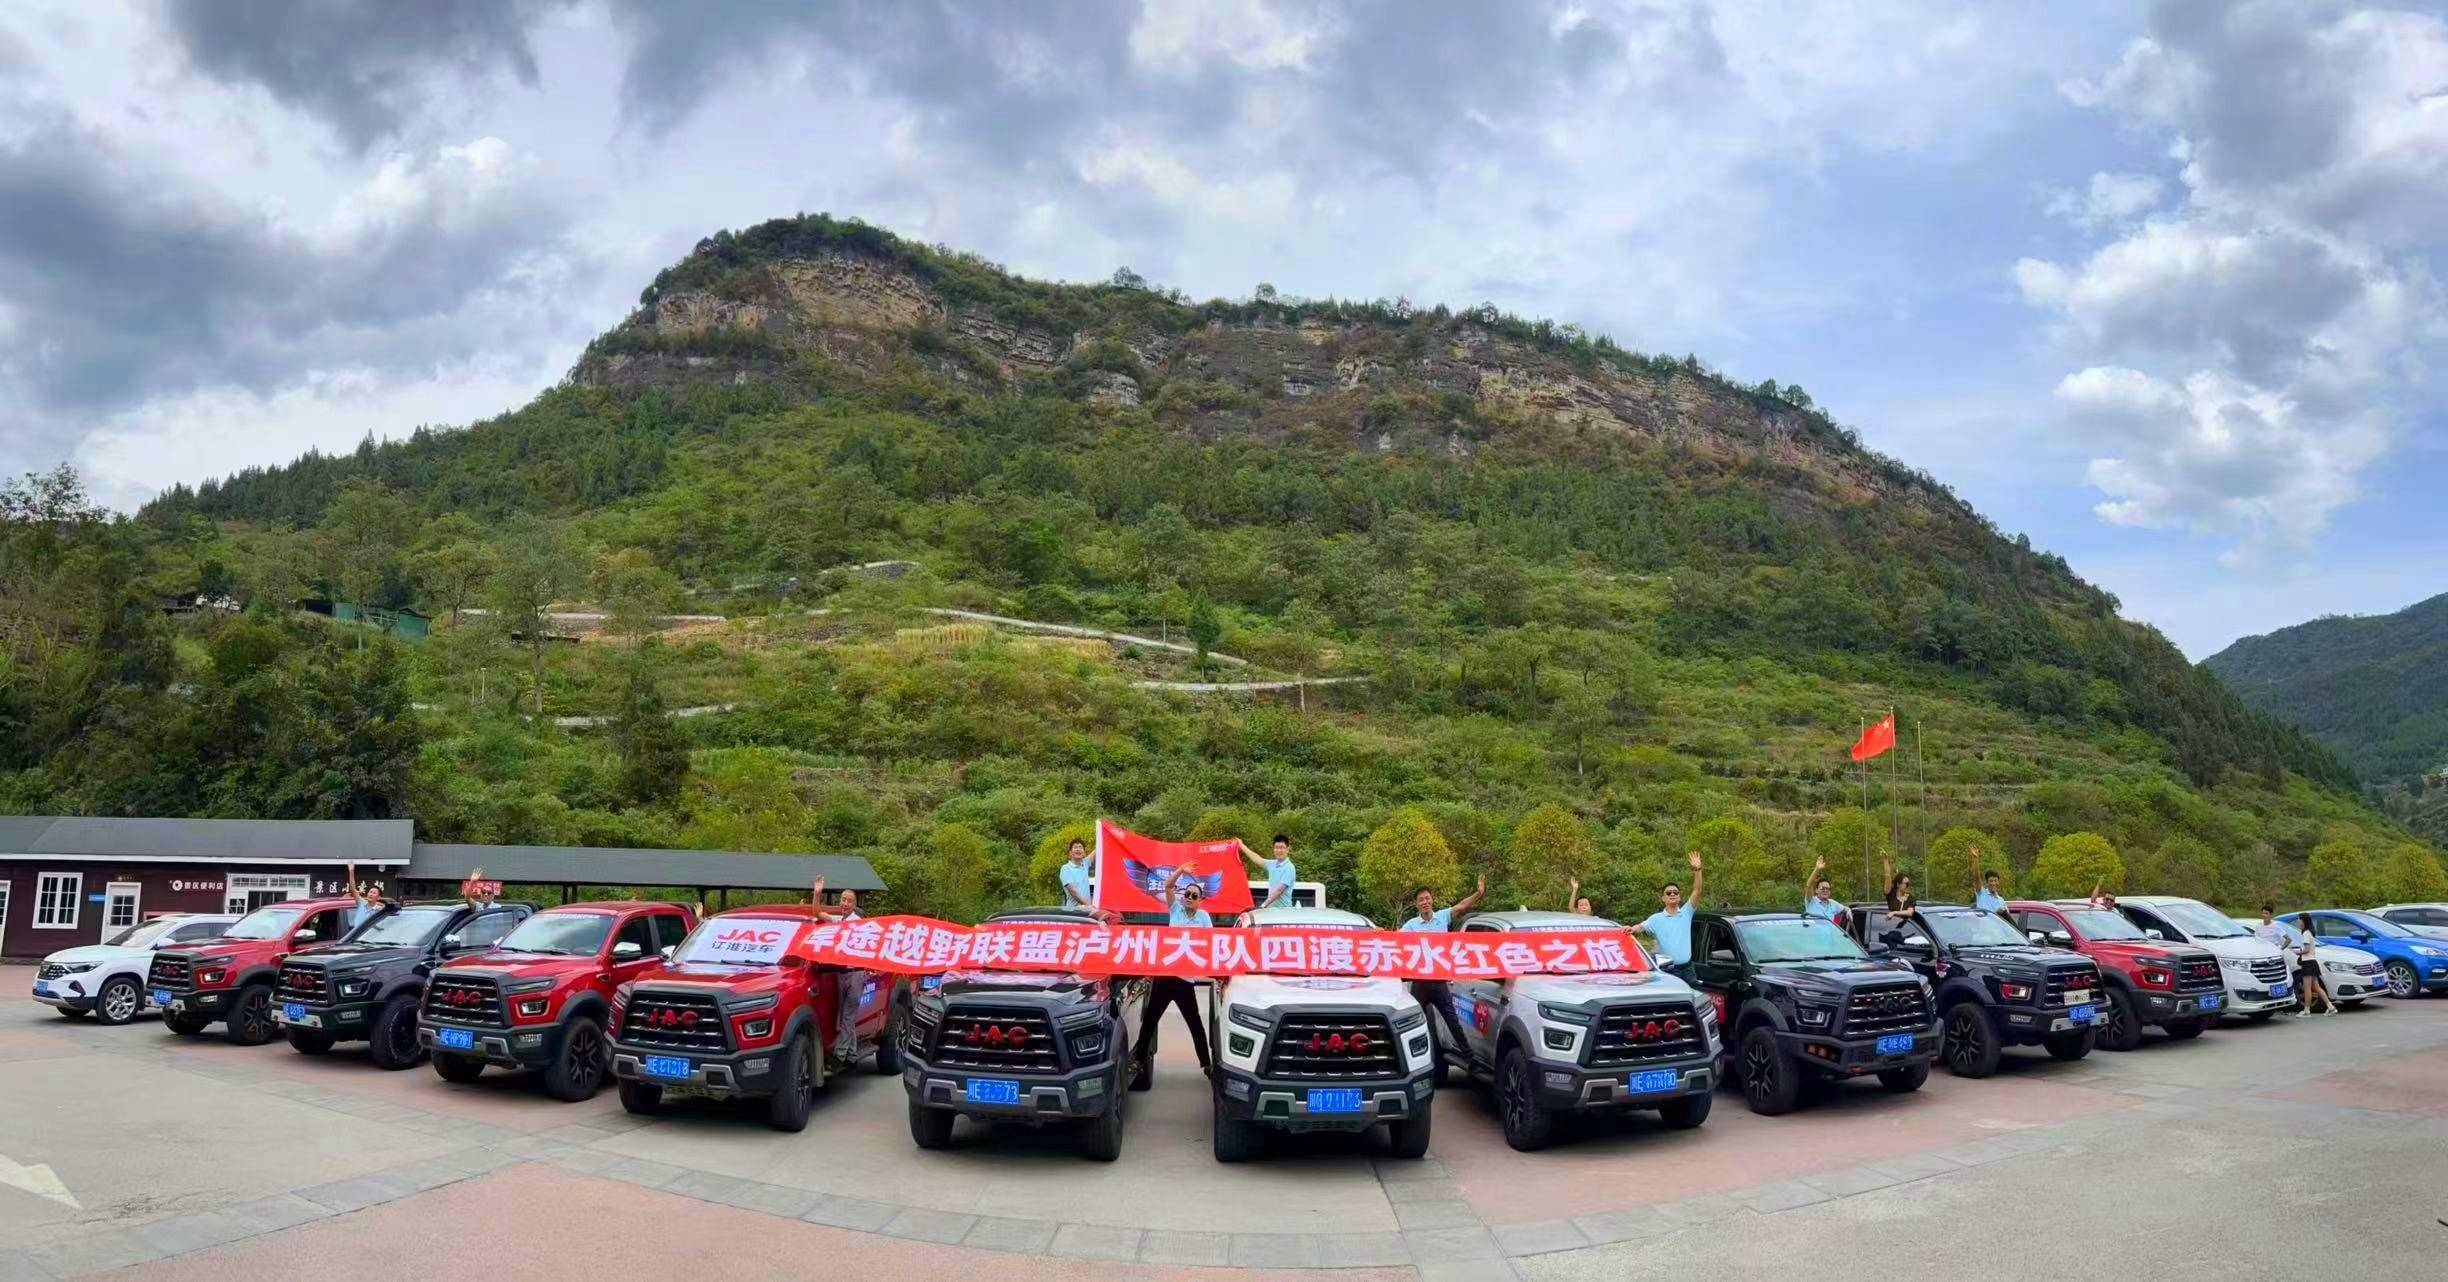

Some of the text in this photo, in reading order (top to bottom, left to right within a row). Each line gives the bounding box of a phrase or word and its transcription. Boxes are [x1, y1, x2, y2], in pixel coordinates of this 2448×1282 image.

[717, 928, 783, 942] JAC
[711, 941, 777, 953] 江淮汽车
[440, 989, 481, 1006] JAC
[648, 1009, 698, 1026] JAC
[965, 1023, 1028, 1044] JAC
[1624, 1019, 1680, 1040] JAC
[1304, 1032, 1369, 1053] JAC
